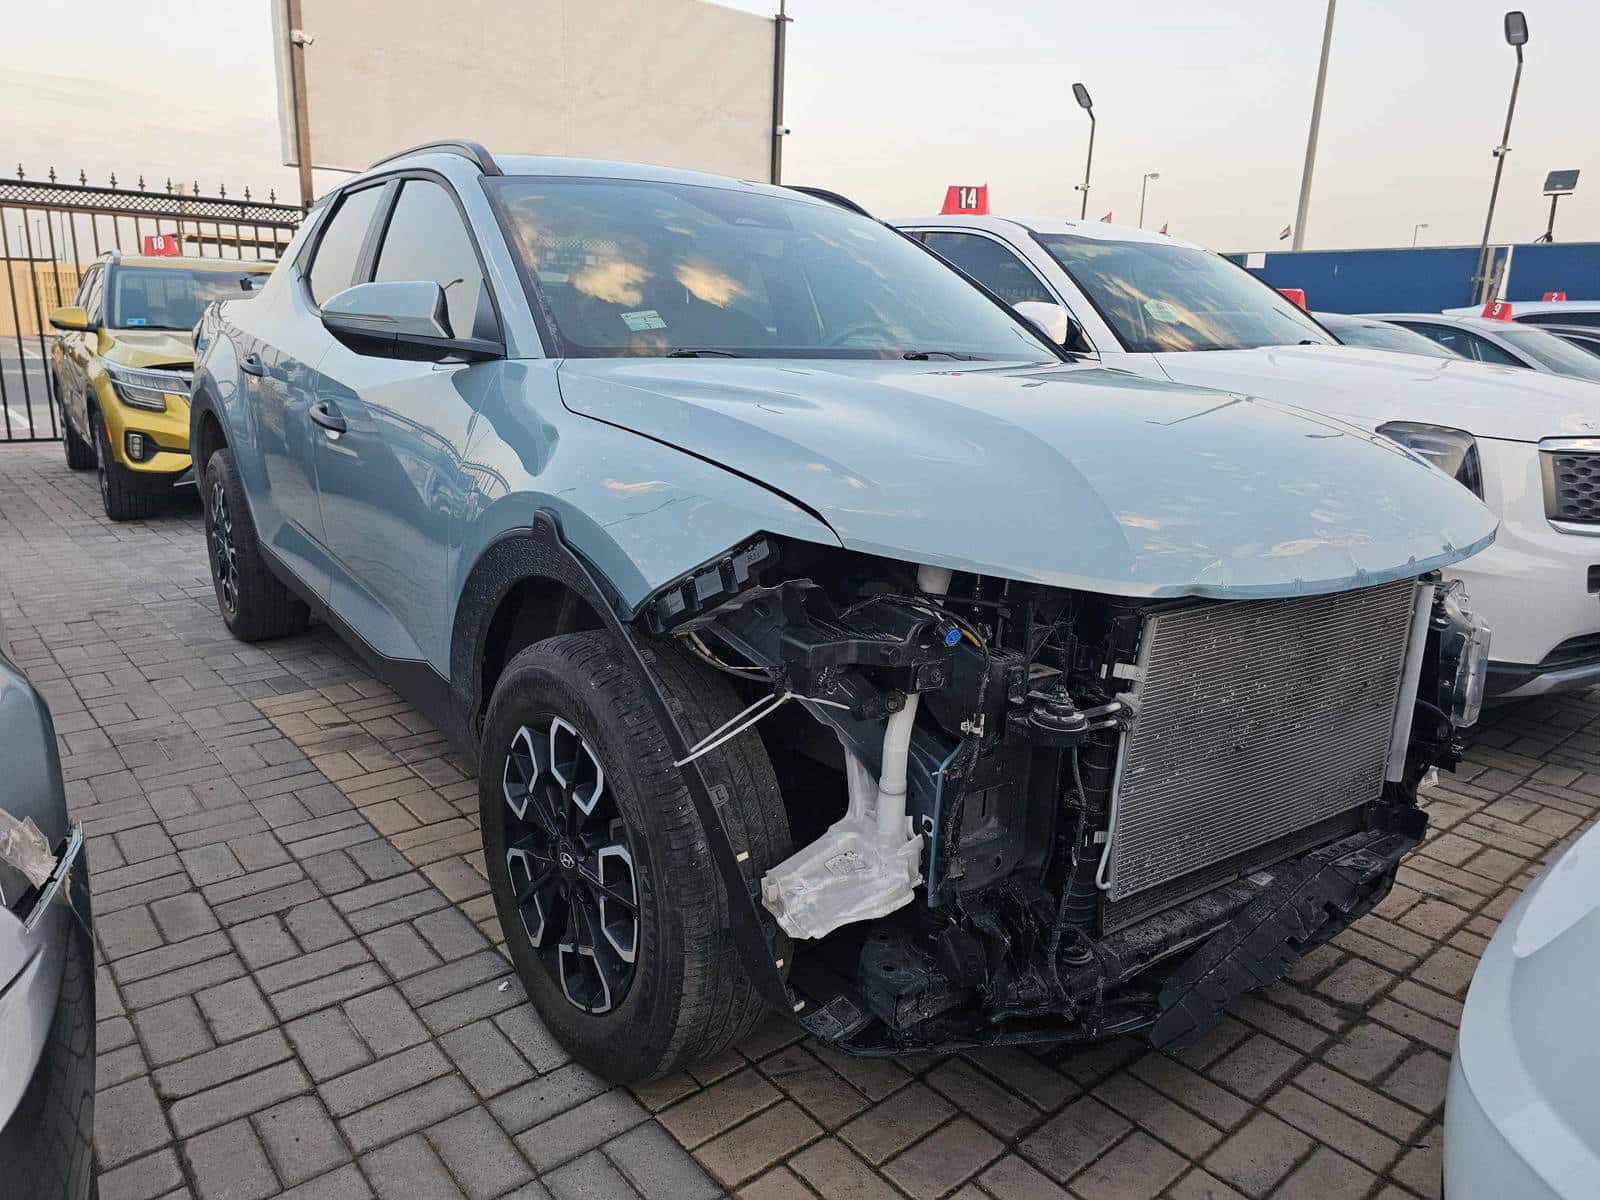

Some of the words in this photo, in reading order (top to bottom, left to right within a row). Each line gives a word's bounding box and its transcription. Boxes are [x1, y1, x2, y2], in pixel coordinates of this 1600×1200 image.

[960, 187, 977, 209] 14
[152, 236, 164, 250] 18
[1551, 292, 1559, 302] 2
[1492, 303, 1502, 316] 9
